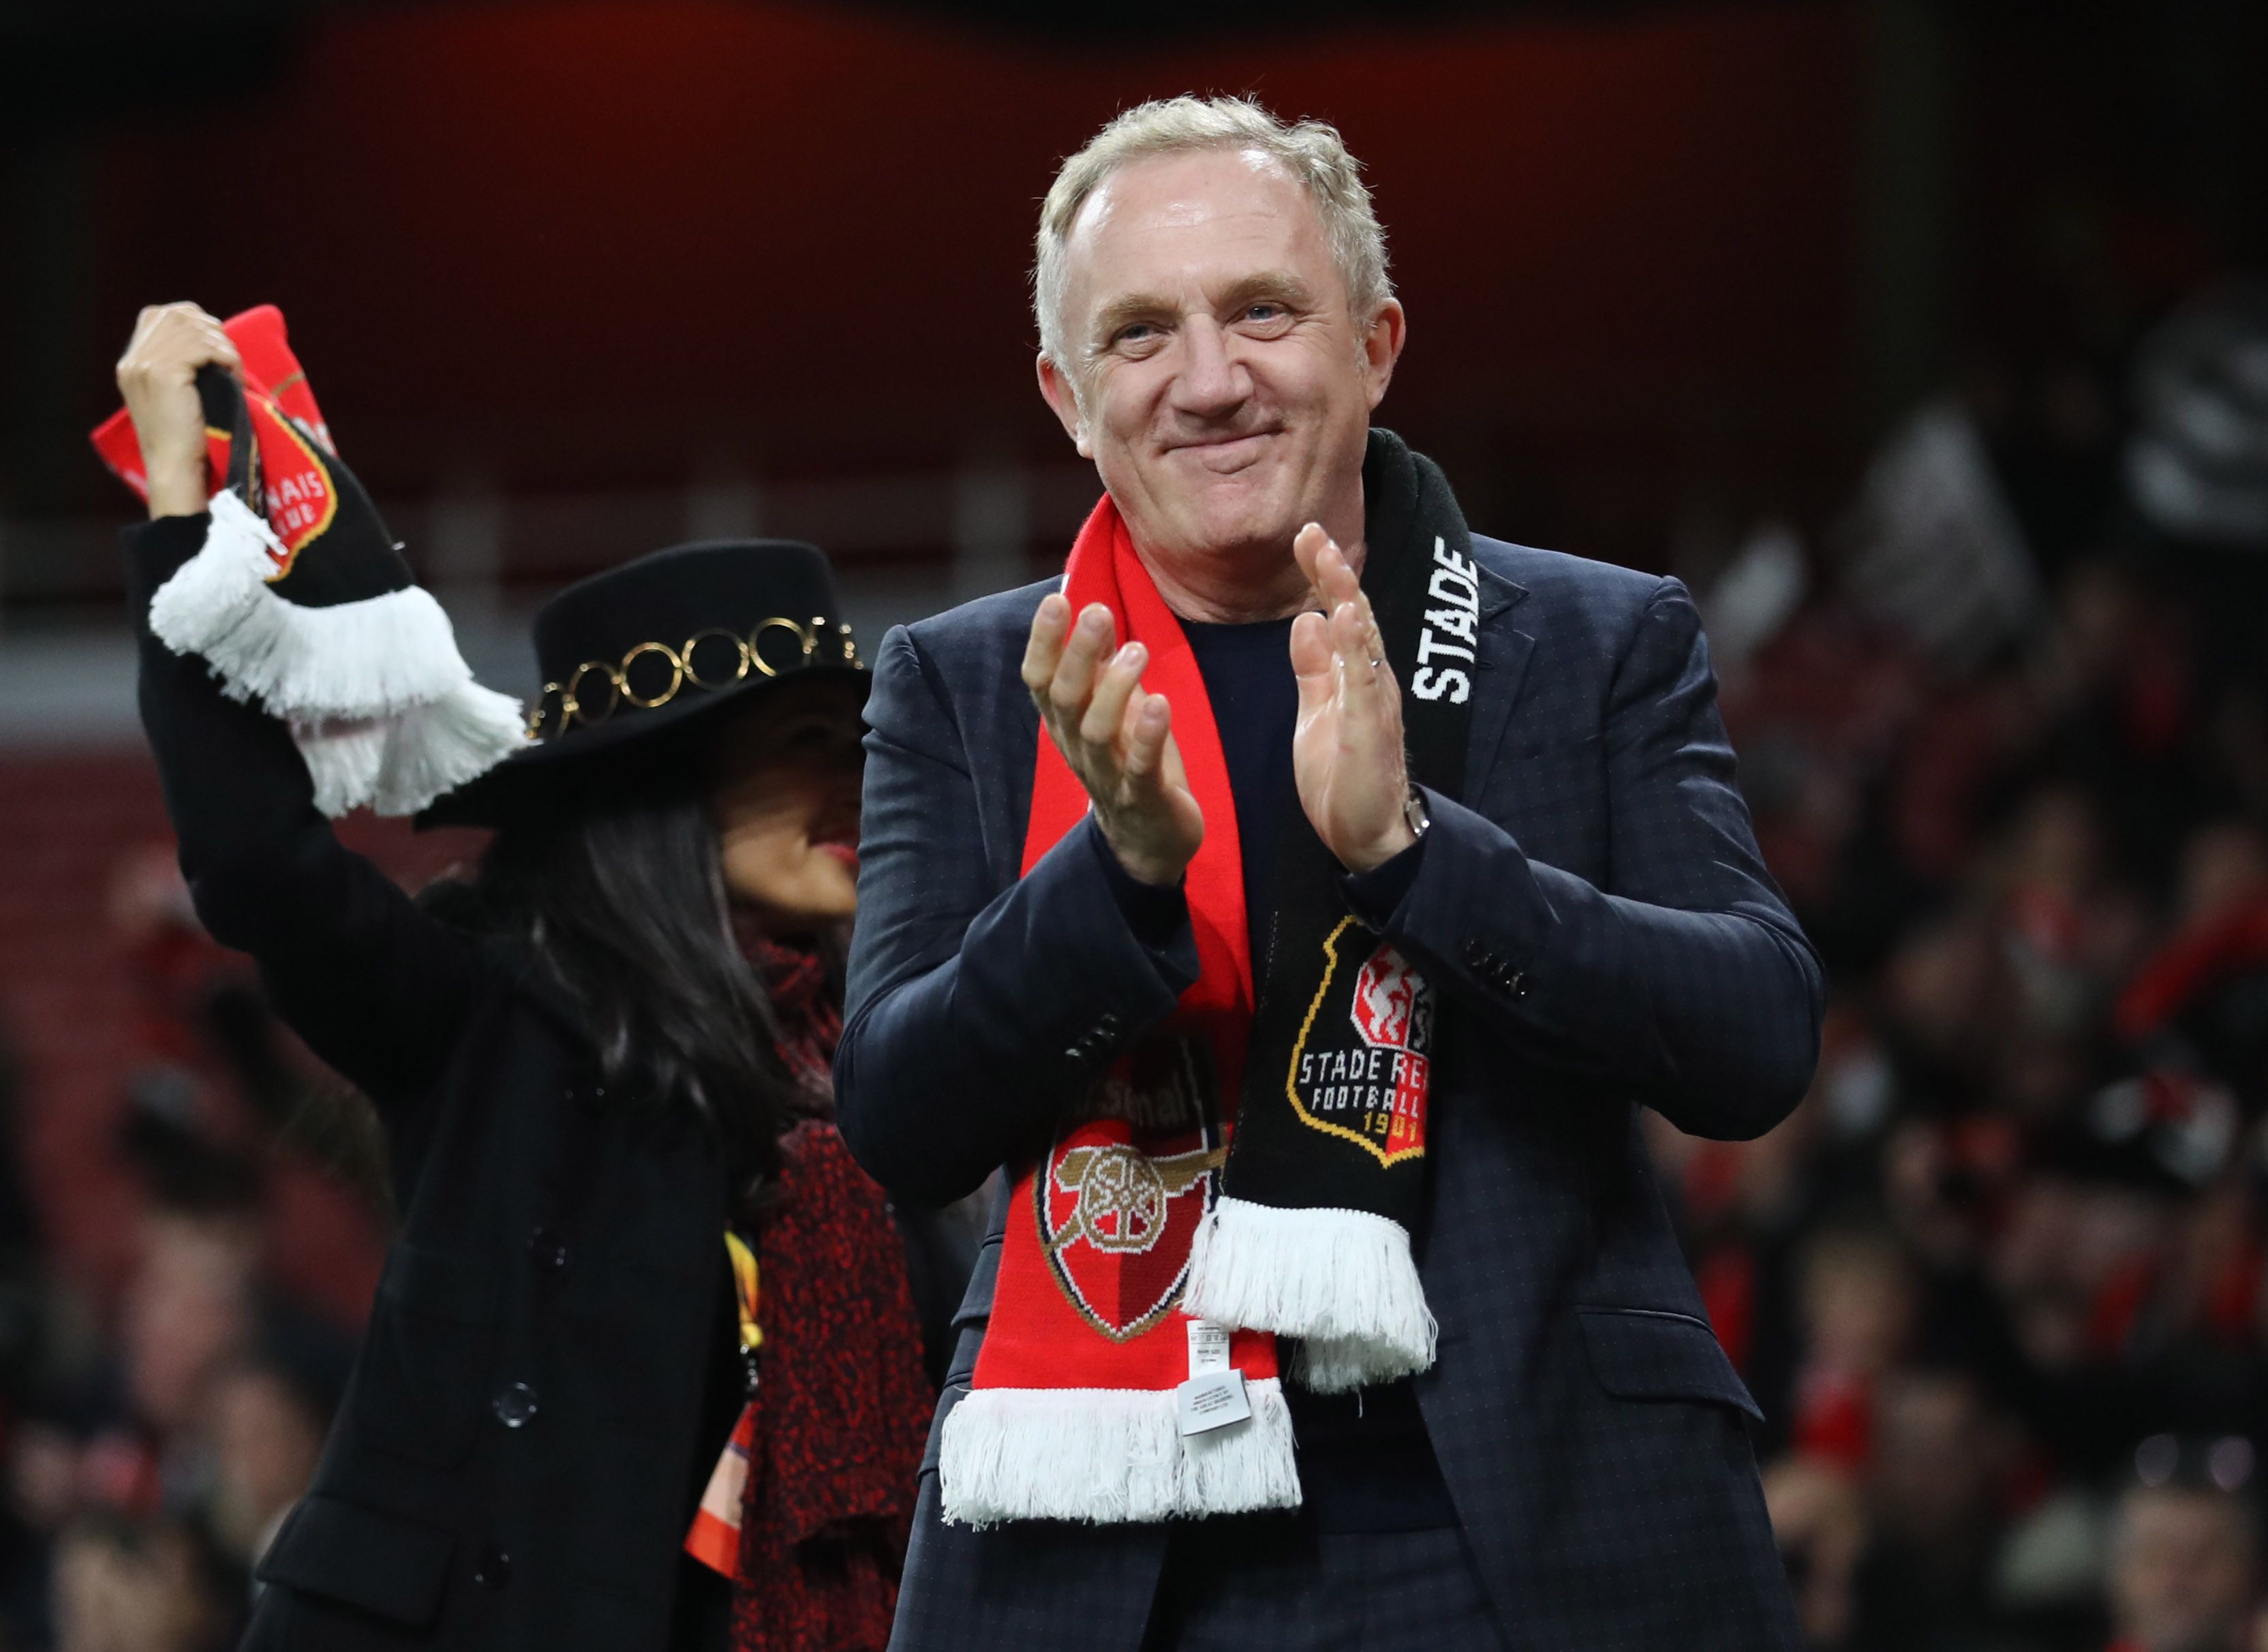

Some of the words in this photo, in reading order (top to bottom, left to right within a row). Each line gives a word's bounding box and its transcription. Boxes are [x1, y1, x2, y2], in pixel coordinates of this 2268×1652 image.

[1411, 536, 1479, 704] STADE
[1299, 1050, 1382, 1084] STADE
[1390, 1052, 1429, 1091] RE
[1312, 1086, 1419, 1118] FOOTBALL
[1364, 1111, 1418, 1142] 1901
